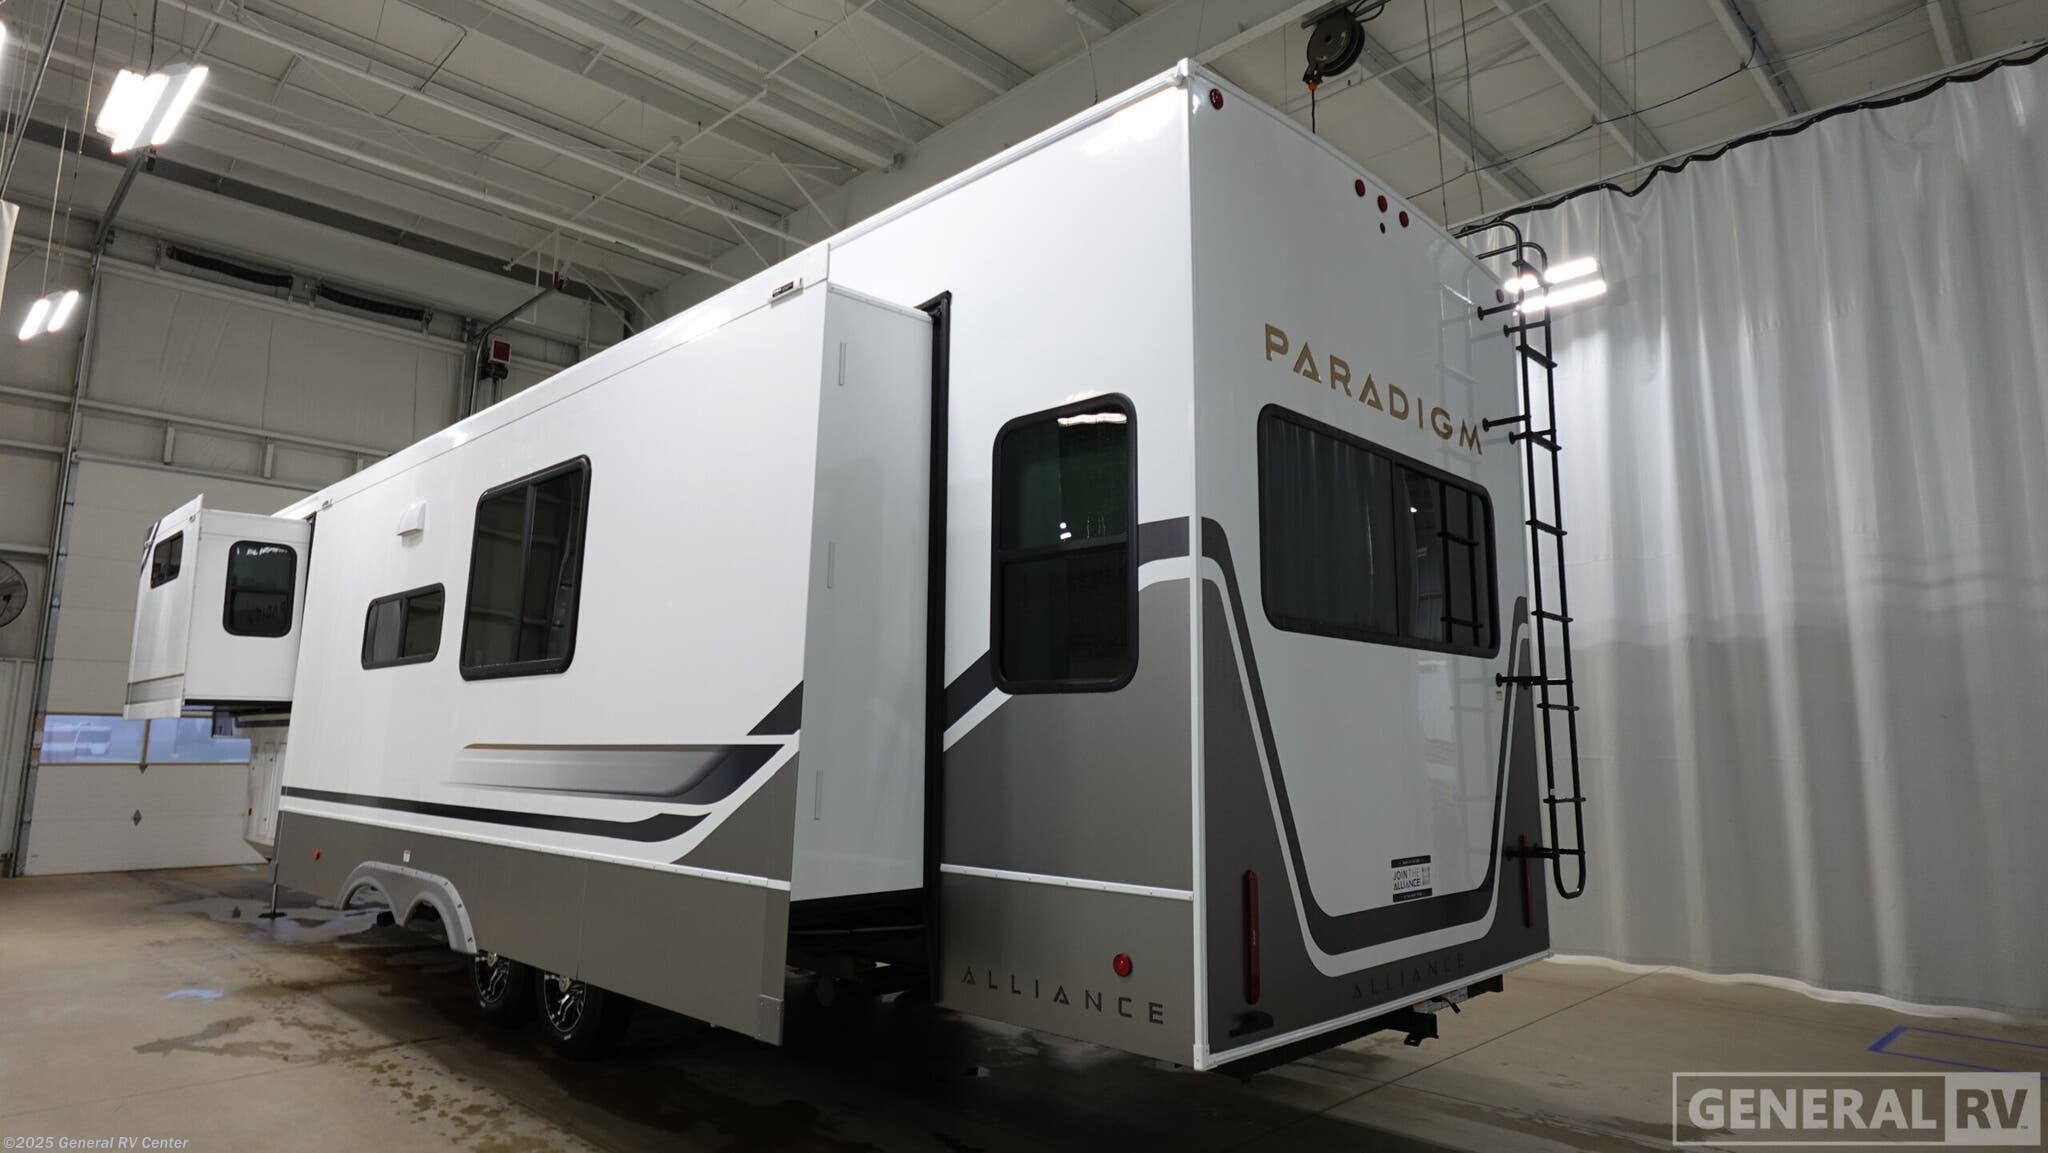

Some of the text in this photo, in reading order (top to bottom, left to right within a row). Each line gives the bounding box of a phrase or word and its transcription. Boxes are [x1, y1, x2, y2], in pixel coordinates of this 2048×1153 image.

[1264, 323, 1483, 455] PARADIGM
[1393, 870, 1408, 881] JOIN
[1393, 878, 1421, 891] ALLIANCE
[961, 966, 1164, 1025] ALLIANCE
[1352, 952, 1465, 1001] ALLIANCE
